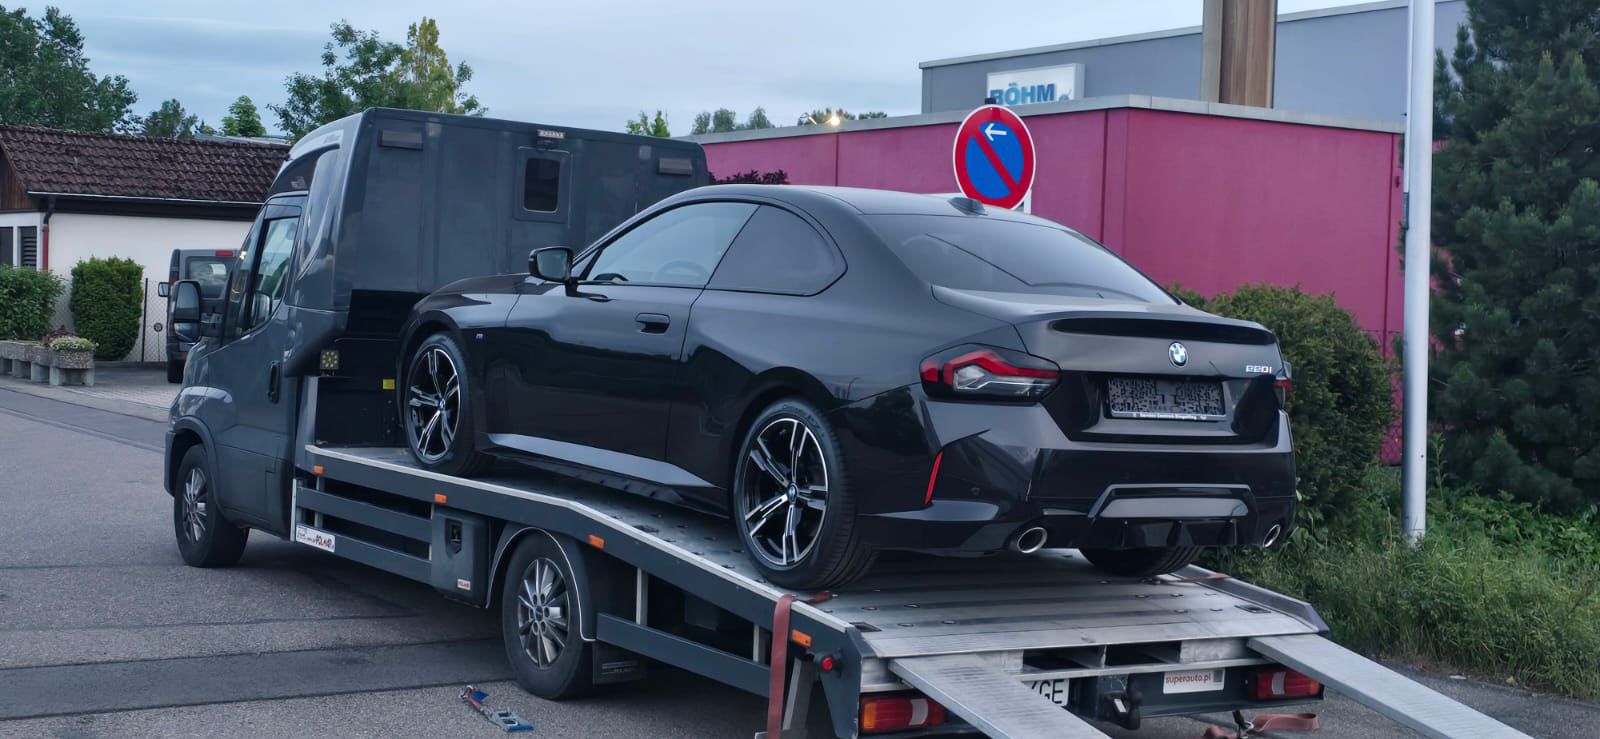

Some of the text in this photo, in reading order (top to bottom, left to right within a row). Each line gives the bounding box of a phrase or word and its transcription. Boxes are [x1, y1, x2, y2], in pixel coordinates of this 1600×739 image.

[990, 82, 1055, 105] BÖHM
[1166, 671, 1211, 684] superauto.pl
[1032, 679, 1064, 704] GE
